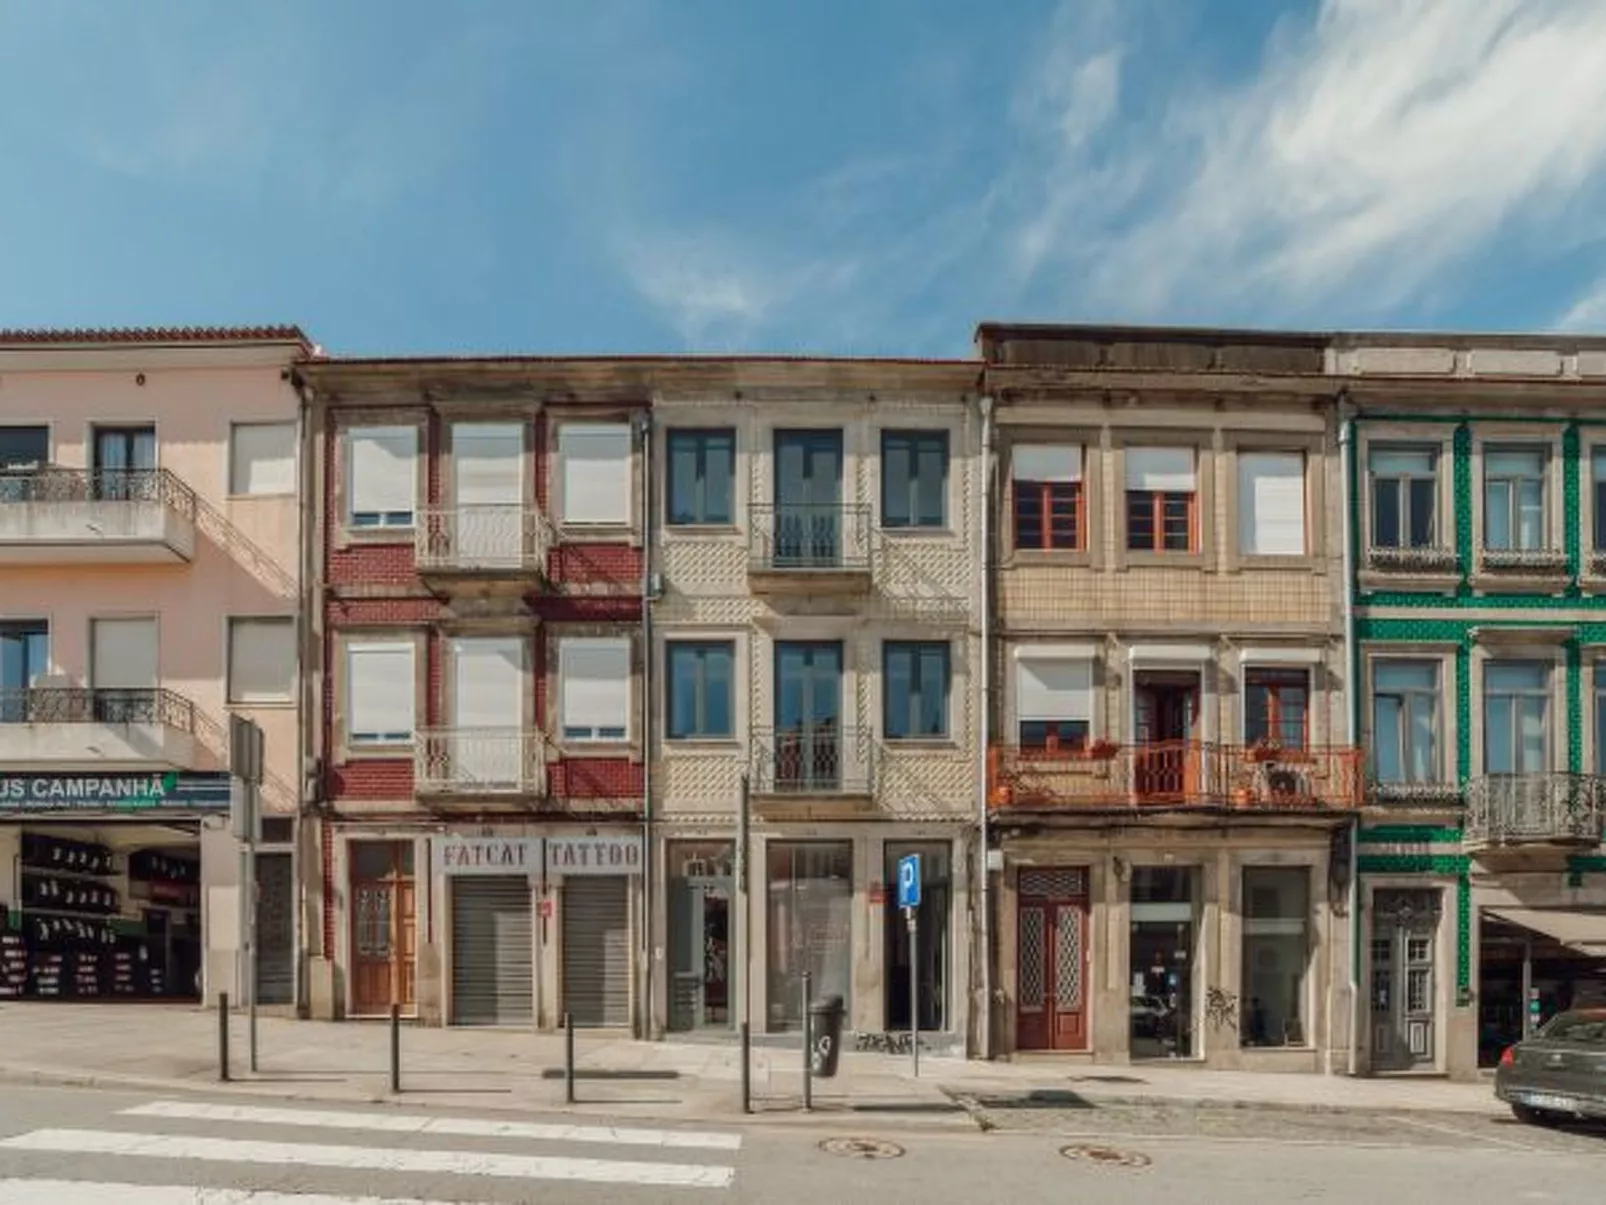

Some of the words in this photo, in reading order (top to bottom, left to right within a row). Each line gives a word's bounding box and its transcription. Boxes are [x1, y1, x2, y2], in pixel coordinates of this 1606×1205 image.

[32, 774, 165, 798] CAMPANHÃ
[443, 843, 528, 866] FATCAT
[549, 843, 639, 866] TATTOO
